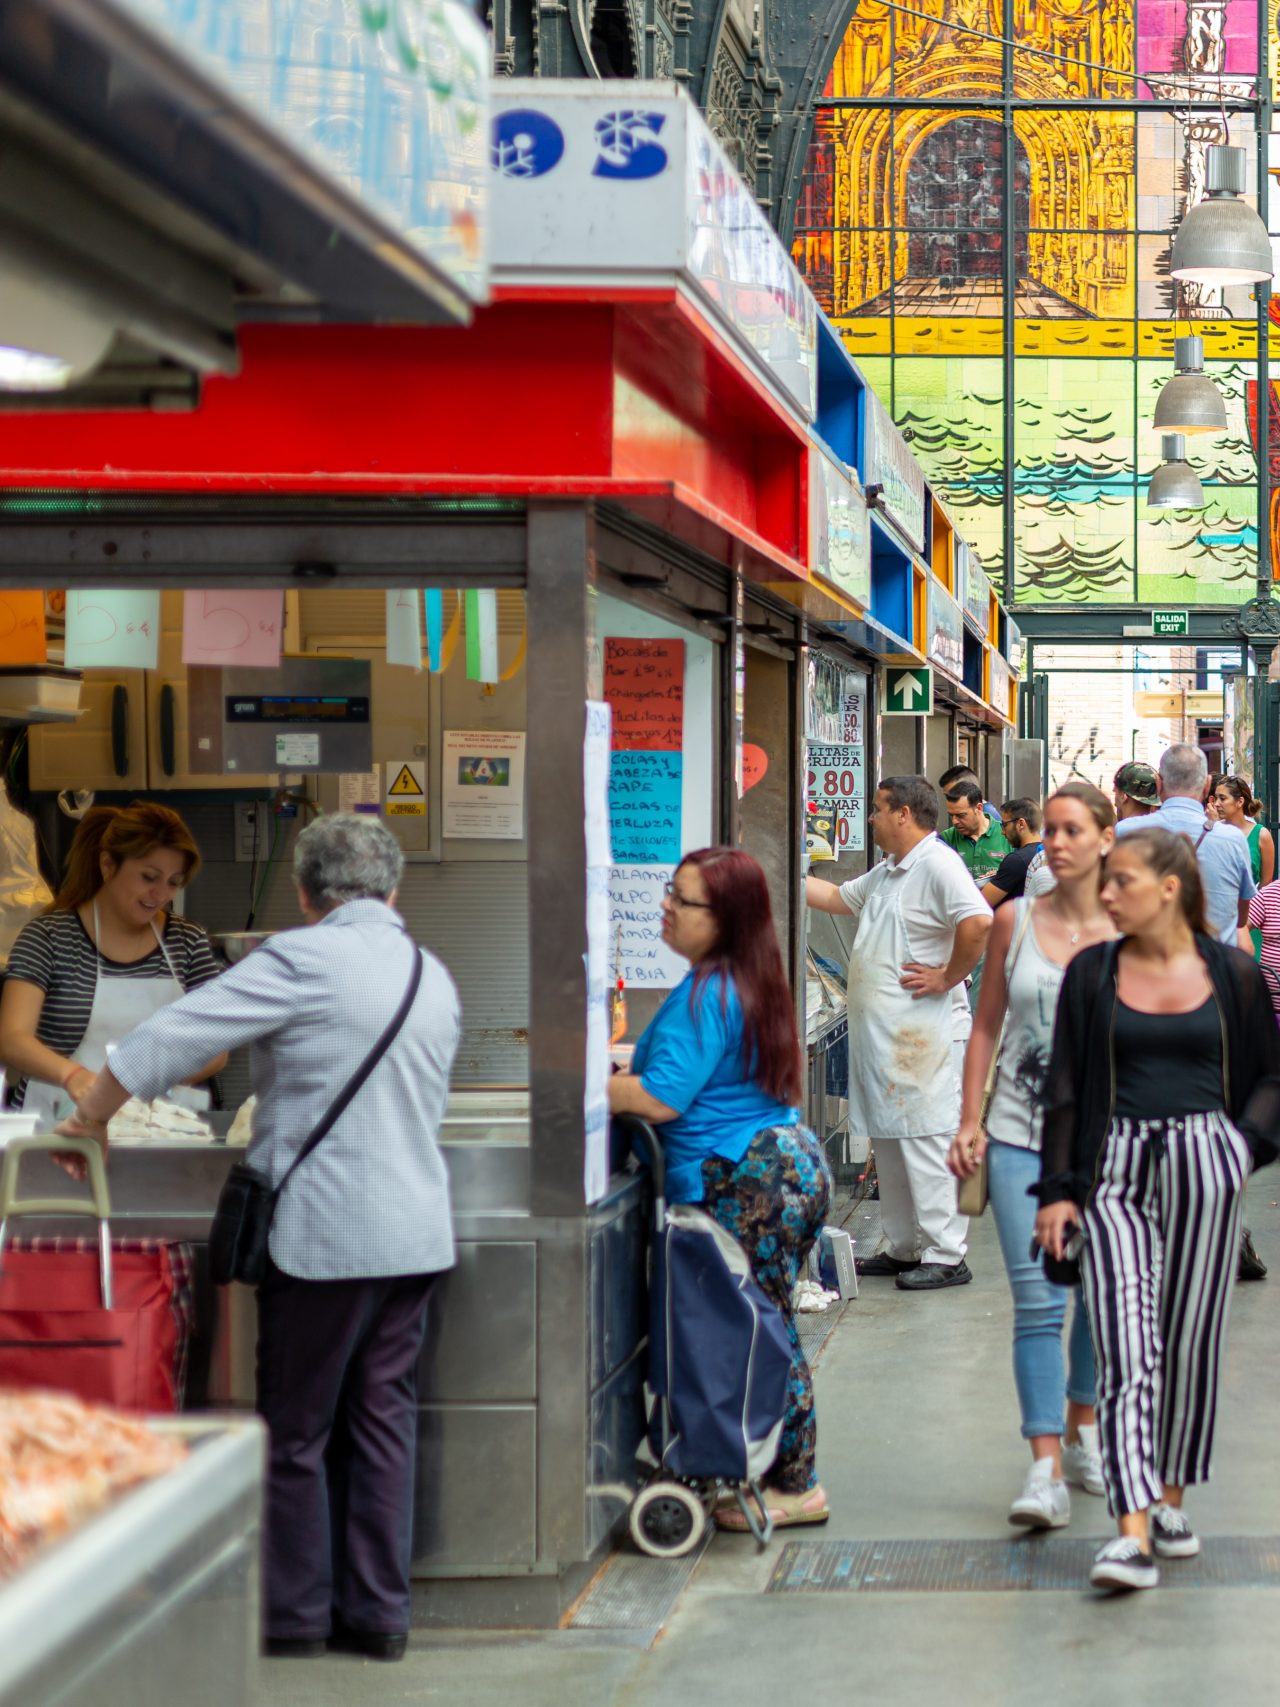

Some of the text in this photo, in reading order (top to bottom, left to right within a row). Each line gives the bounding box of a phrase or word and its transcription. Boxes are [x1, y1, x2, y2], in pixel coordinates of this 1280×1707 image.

[1155, 614, 1185, 623] SALIDA
[1160, 623, 1180, 632] EXIT
[808, 747, 849, 757] LITAS
[611, 754, 657, 765] COLAS
[609, 801, 661, 811] COLAS
[609, 869, 670, 881] ALAMA
